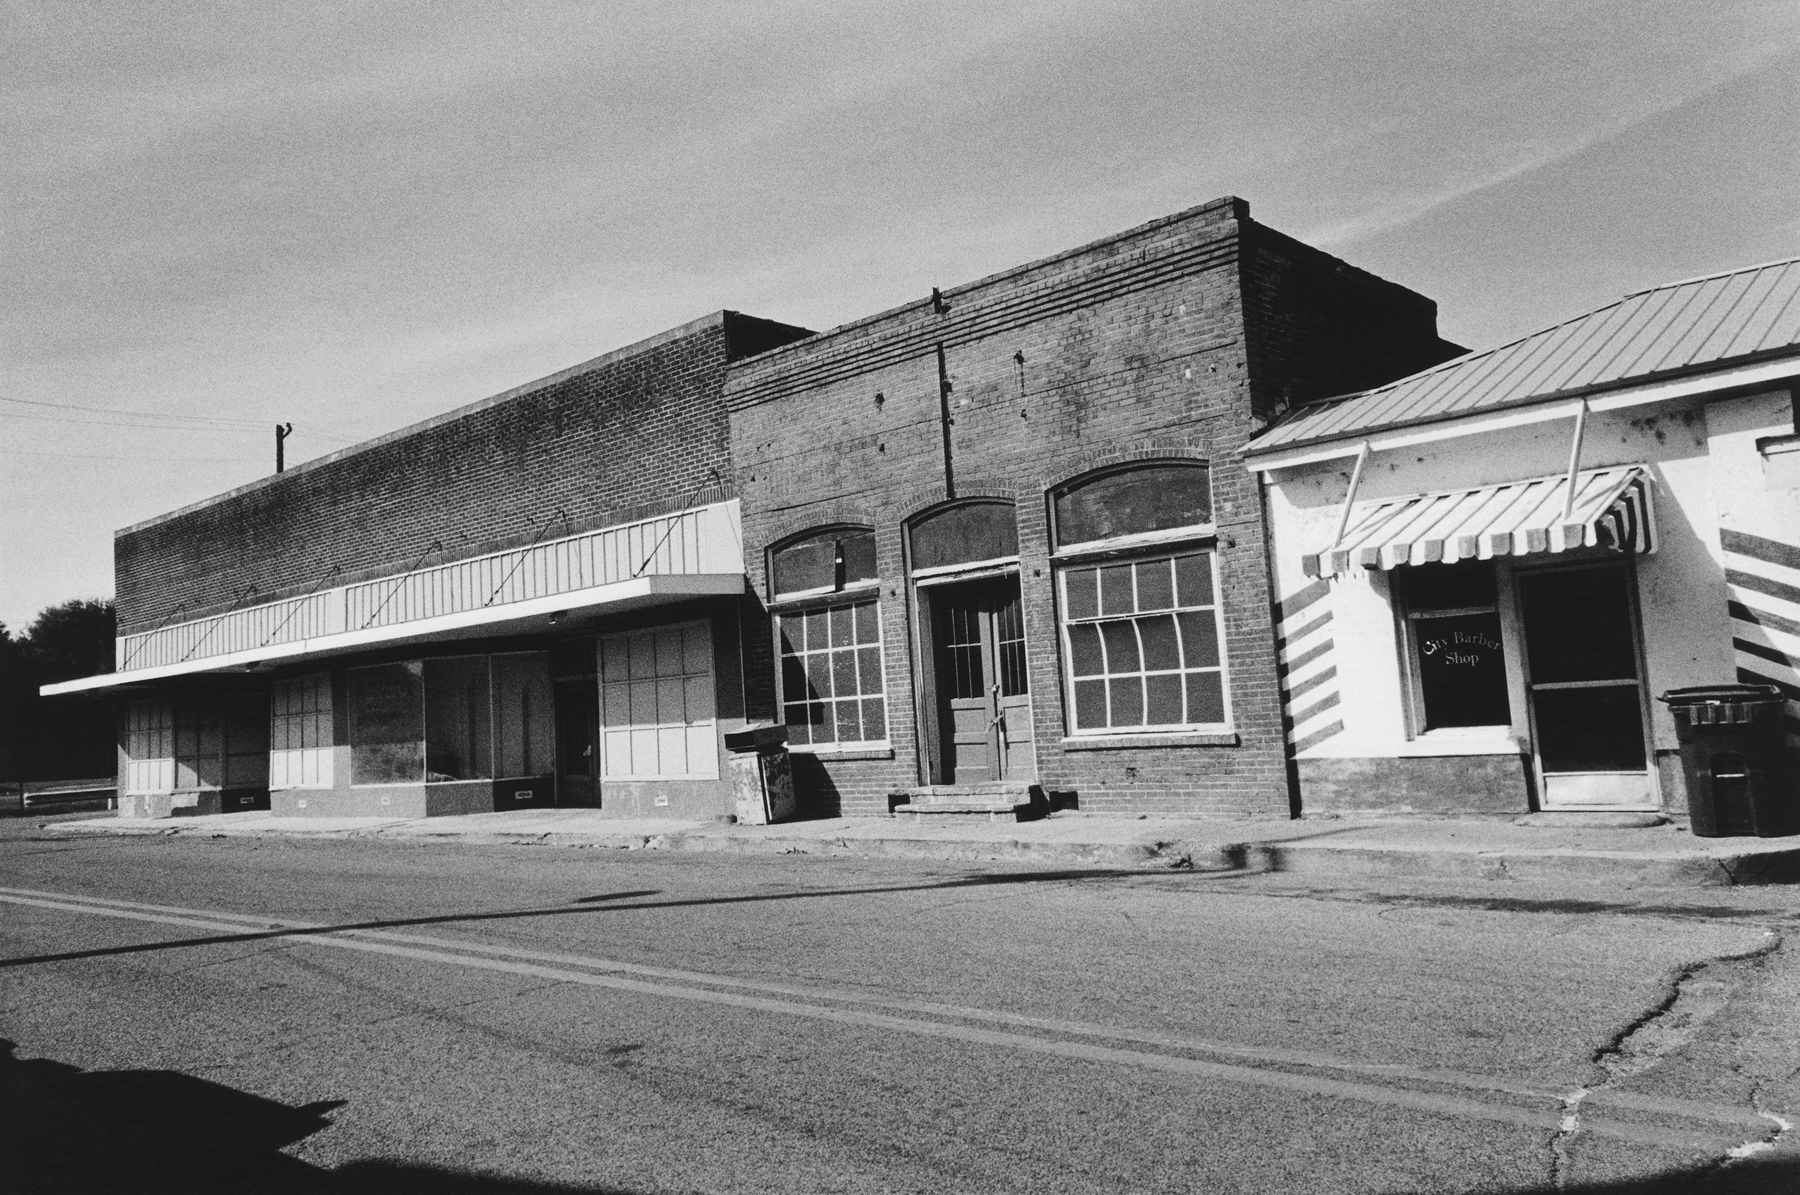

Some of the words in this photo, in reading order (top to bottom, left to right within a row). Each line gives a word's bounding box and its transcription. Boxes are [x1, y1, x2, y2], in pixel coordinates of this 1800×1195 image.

[1422, 637, 1448, 655] City
[1453, 631, 1501, 650] Barber
[1445, 652, 1479, 667] Shop
